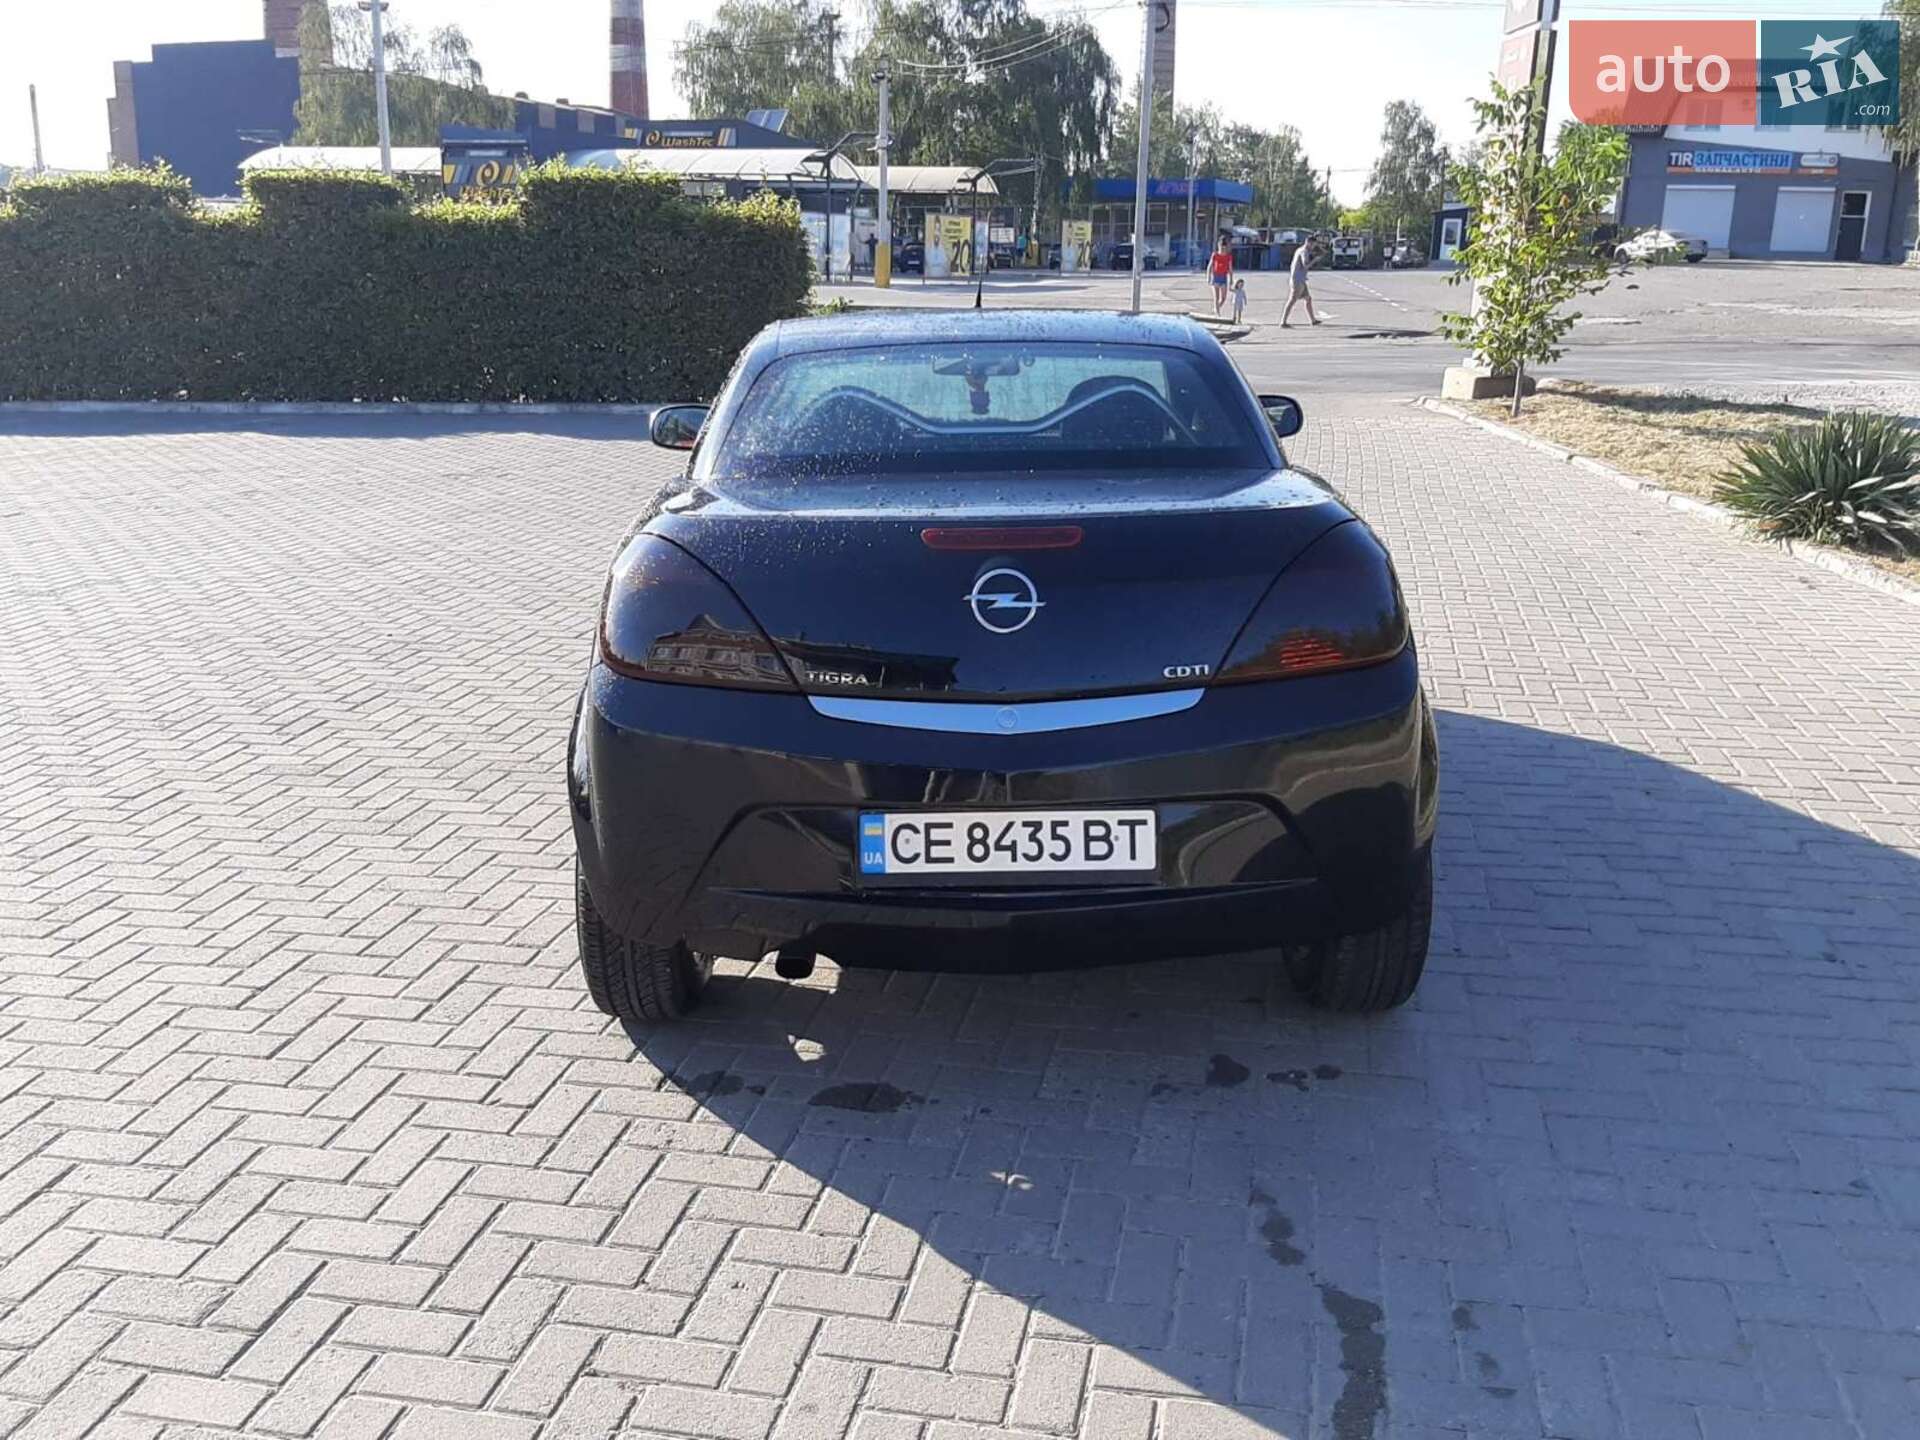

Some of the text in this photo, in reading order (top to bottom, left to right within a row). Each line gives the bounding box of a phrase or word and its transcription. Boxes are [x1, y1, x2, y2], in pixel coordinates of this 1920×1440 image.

[1669, 152, 1693, 167] TIR
[1694, 152, 1792, 168] ЗАПЧАСТИНИ
[805, 670, 869, 686] TIGRA
[1163, 664, 1210, 679] CDTI
[890, 818, 1148, 864] CE 8435 BT
[864, 853, 883, 866] UA
